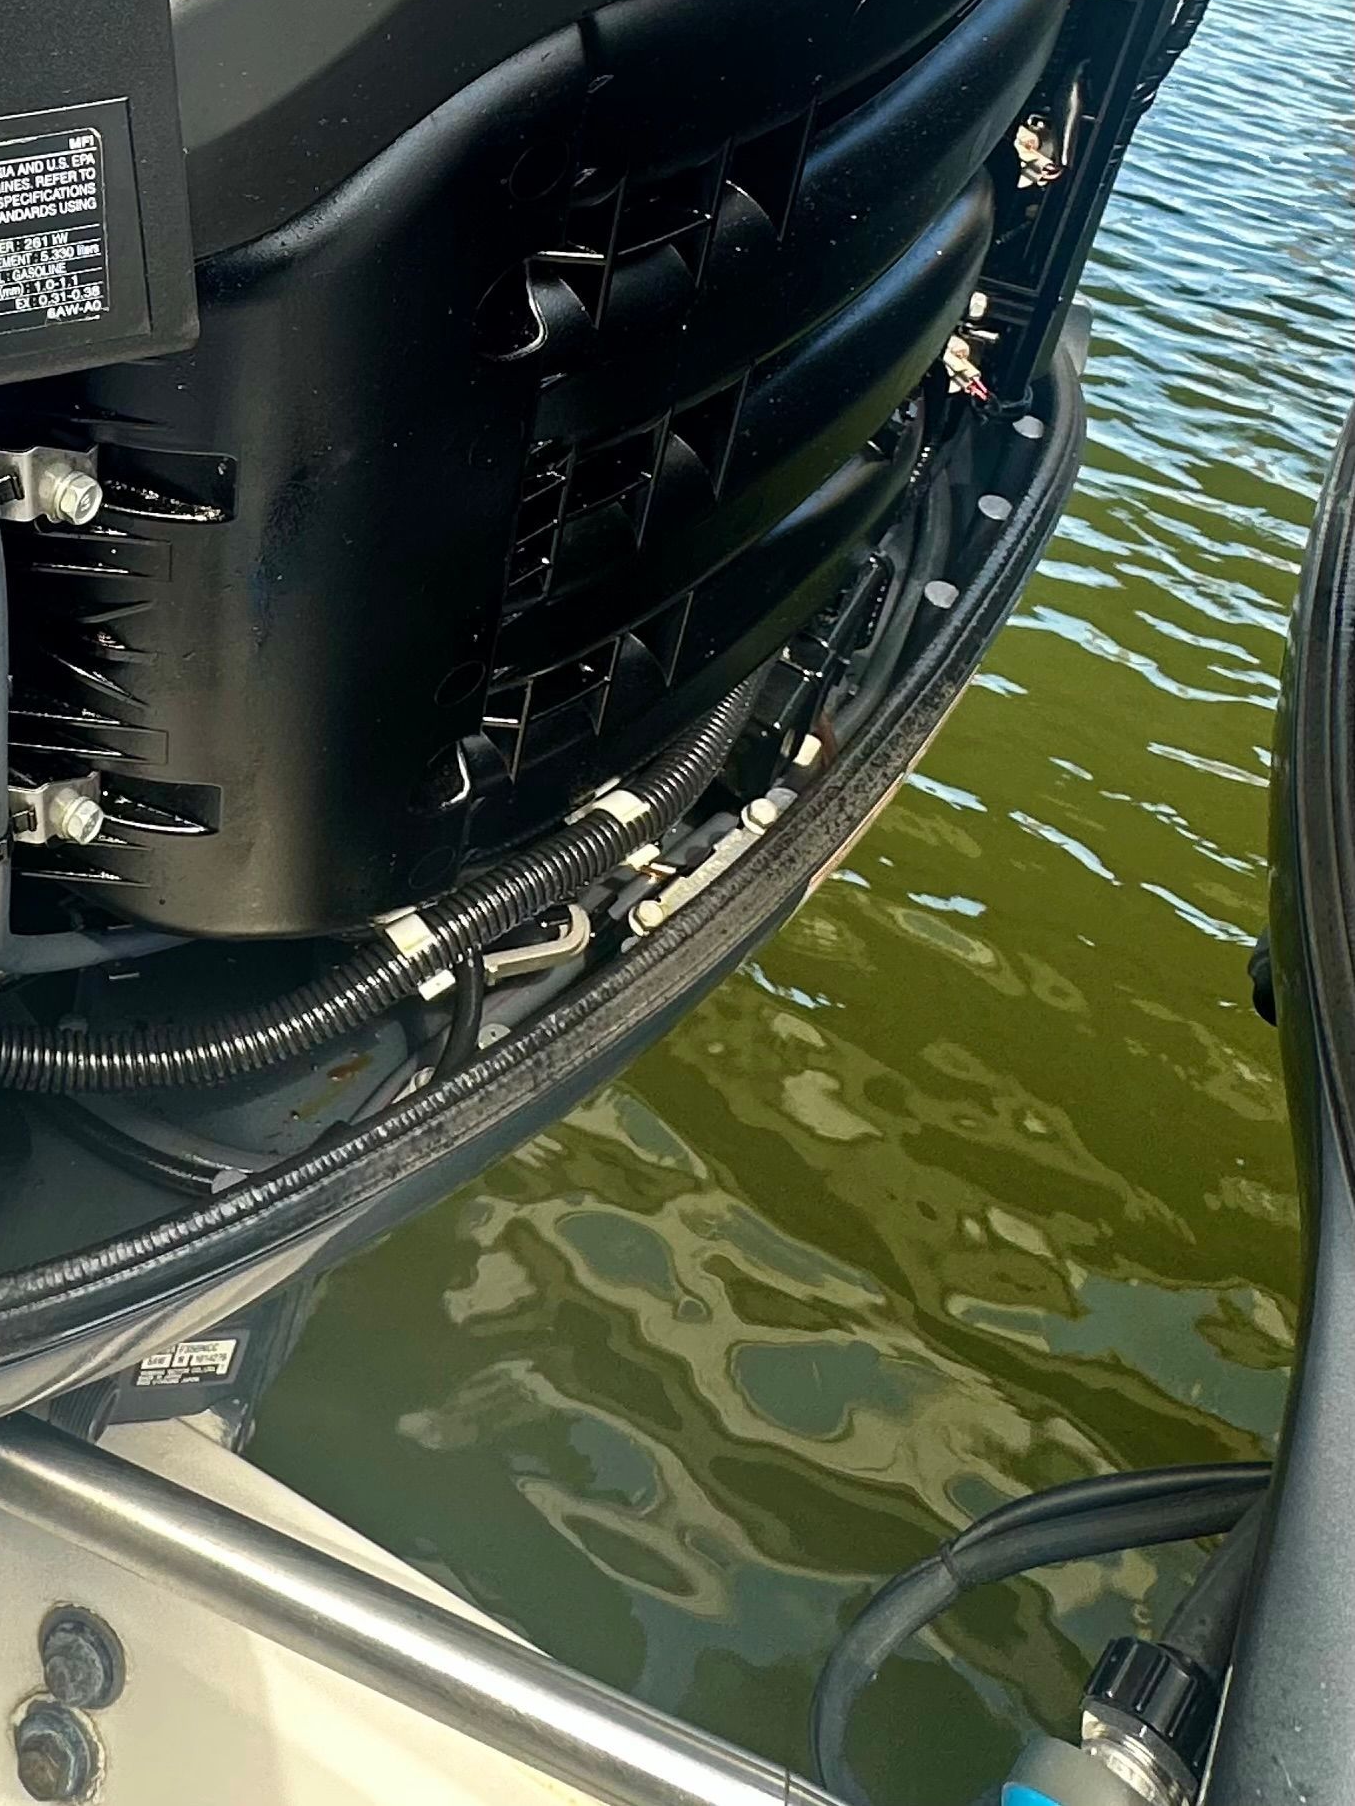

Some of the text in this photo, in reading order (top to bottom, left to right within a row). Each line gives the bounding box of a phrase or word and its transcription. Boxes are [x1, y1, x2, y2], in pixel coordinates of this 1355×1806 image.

[69, 135, 95, 149] MFI
[18, 161, 43, 173] AND
[47, 157, 69, 170] U.S.
[72, 153, 95, 165] EPA
[35, 171, 77, 188] REFER
[80, 167, 95, 181] TO
[59, 197, 97, 214] USING
[52, 232, 68, 245] kW
[12, 263, 67, 281] GASOLINE
